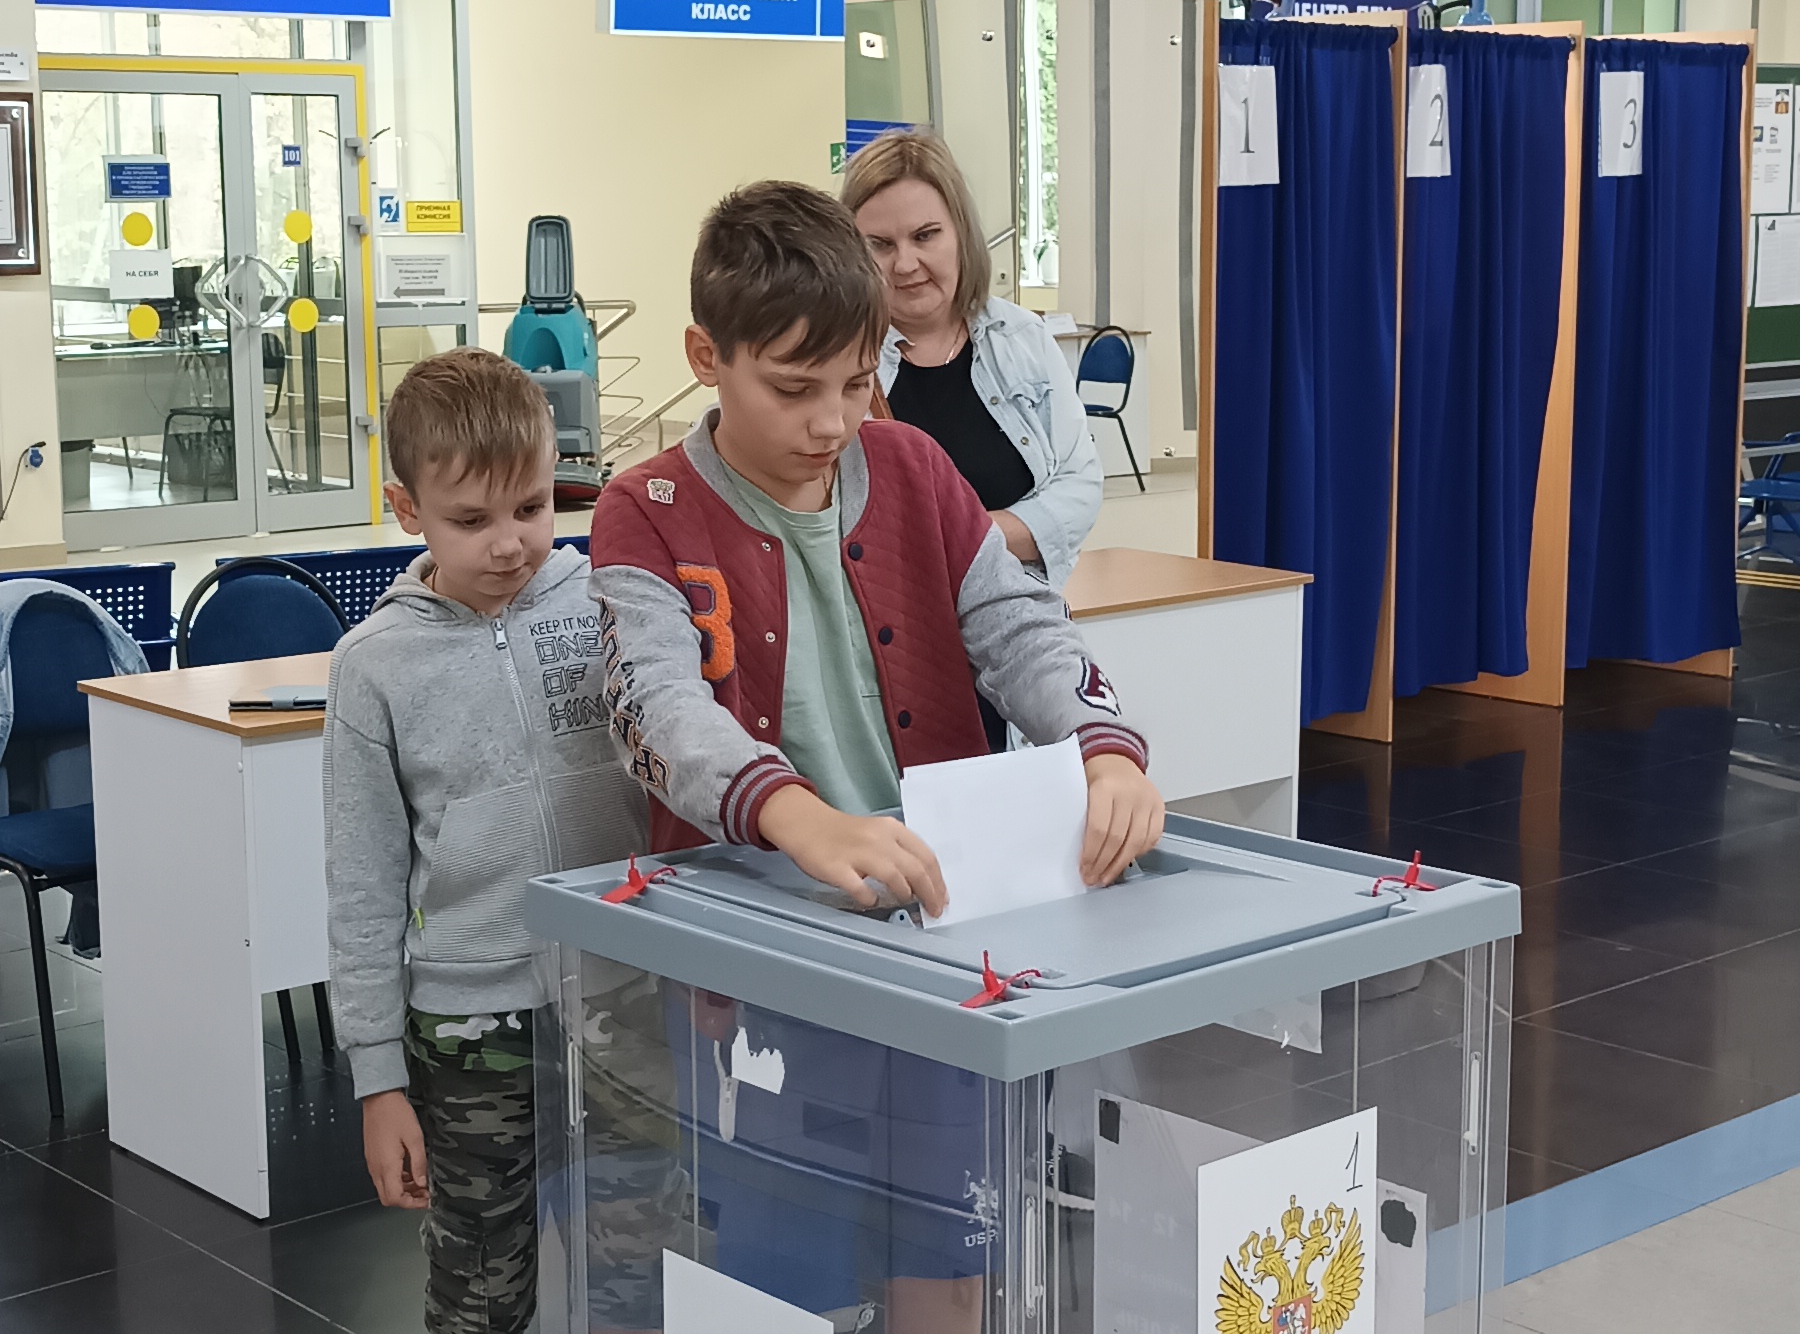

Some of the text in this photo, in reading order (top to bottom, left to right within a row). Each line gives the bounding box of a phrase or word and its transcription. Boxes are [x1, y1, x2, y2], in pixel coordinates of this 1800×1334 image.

[691, 2, 751, 21] КЛАСС
[1239, 96, 1256, 155] 1
[1428, 92, 1446, 148] 2
[1622, 98, 1638, 150] 3
[284, 149, 301, 162] 101
[125, 270, 159, 278] НА СЕБЯ
[529, 619, 560, 637] KEEP
[563, 617, 574, 631] IT
[535, 630, 605, 665] ONE
[542, 662, 588, 698] OF
[548, 693, 610, 732] KIN
[1343, 1130, 1364, 1193] 1
